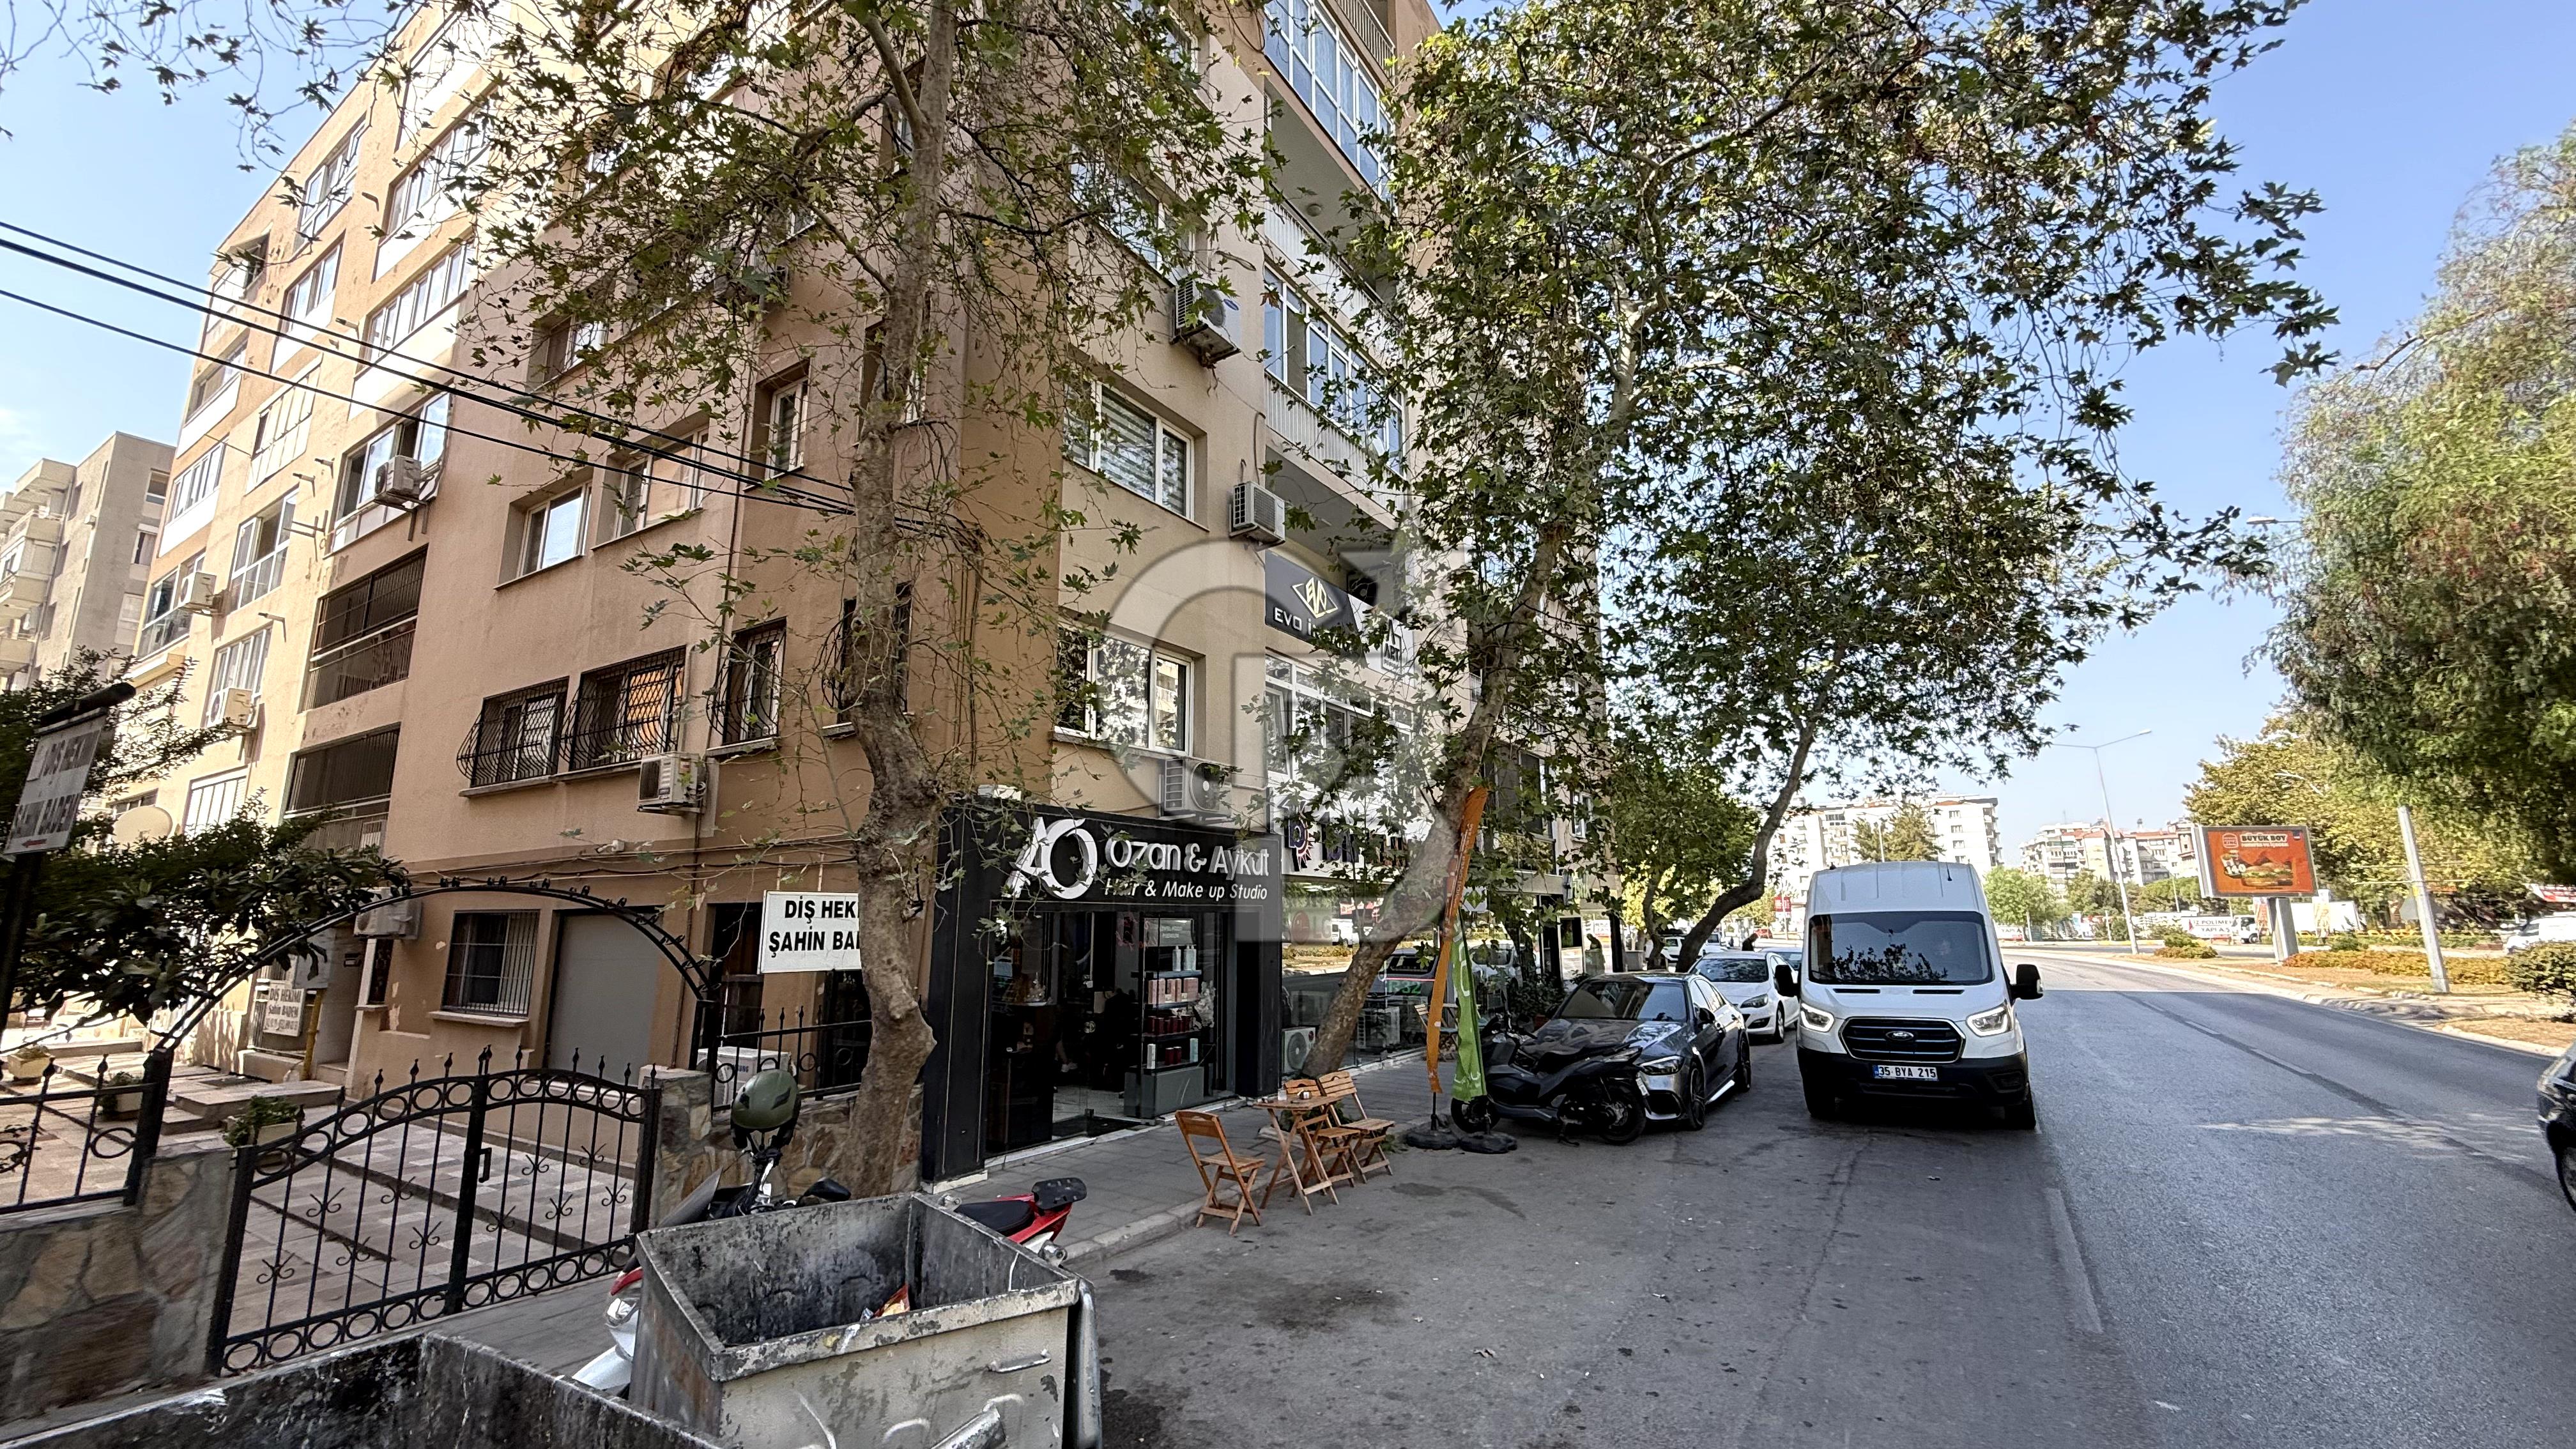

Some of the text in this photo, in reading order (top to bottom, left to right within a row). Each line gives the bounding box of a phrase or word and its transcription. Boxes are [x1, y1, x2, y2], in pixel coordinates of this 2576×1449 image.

[1273, 607, 1302, 632] EVO
[1184, 843, 1207, 873] &
[1208, 845, 1269, 881] Aykut
[1144, 880, 1156, 896] &
[1162, 881, 1204, 898] Make
[1208, 885, 1225, 901] up
[1229, 883, 1268, 900] Studio
[785, 895, 860, 924] DİŞ HEK
[1313, 915, 1332, 939] LG
[769, 925, 825, 958] ŞAHİN
[1878, 1066, 1936, 1078] 35 BYA 215
